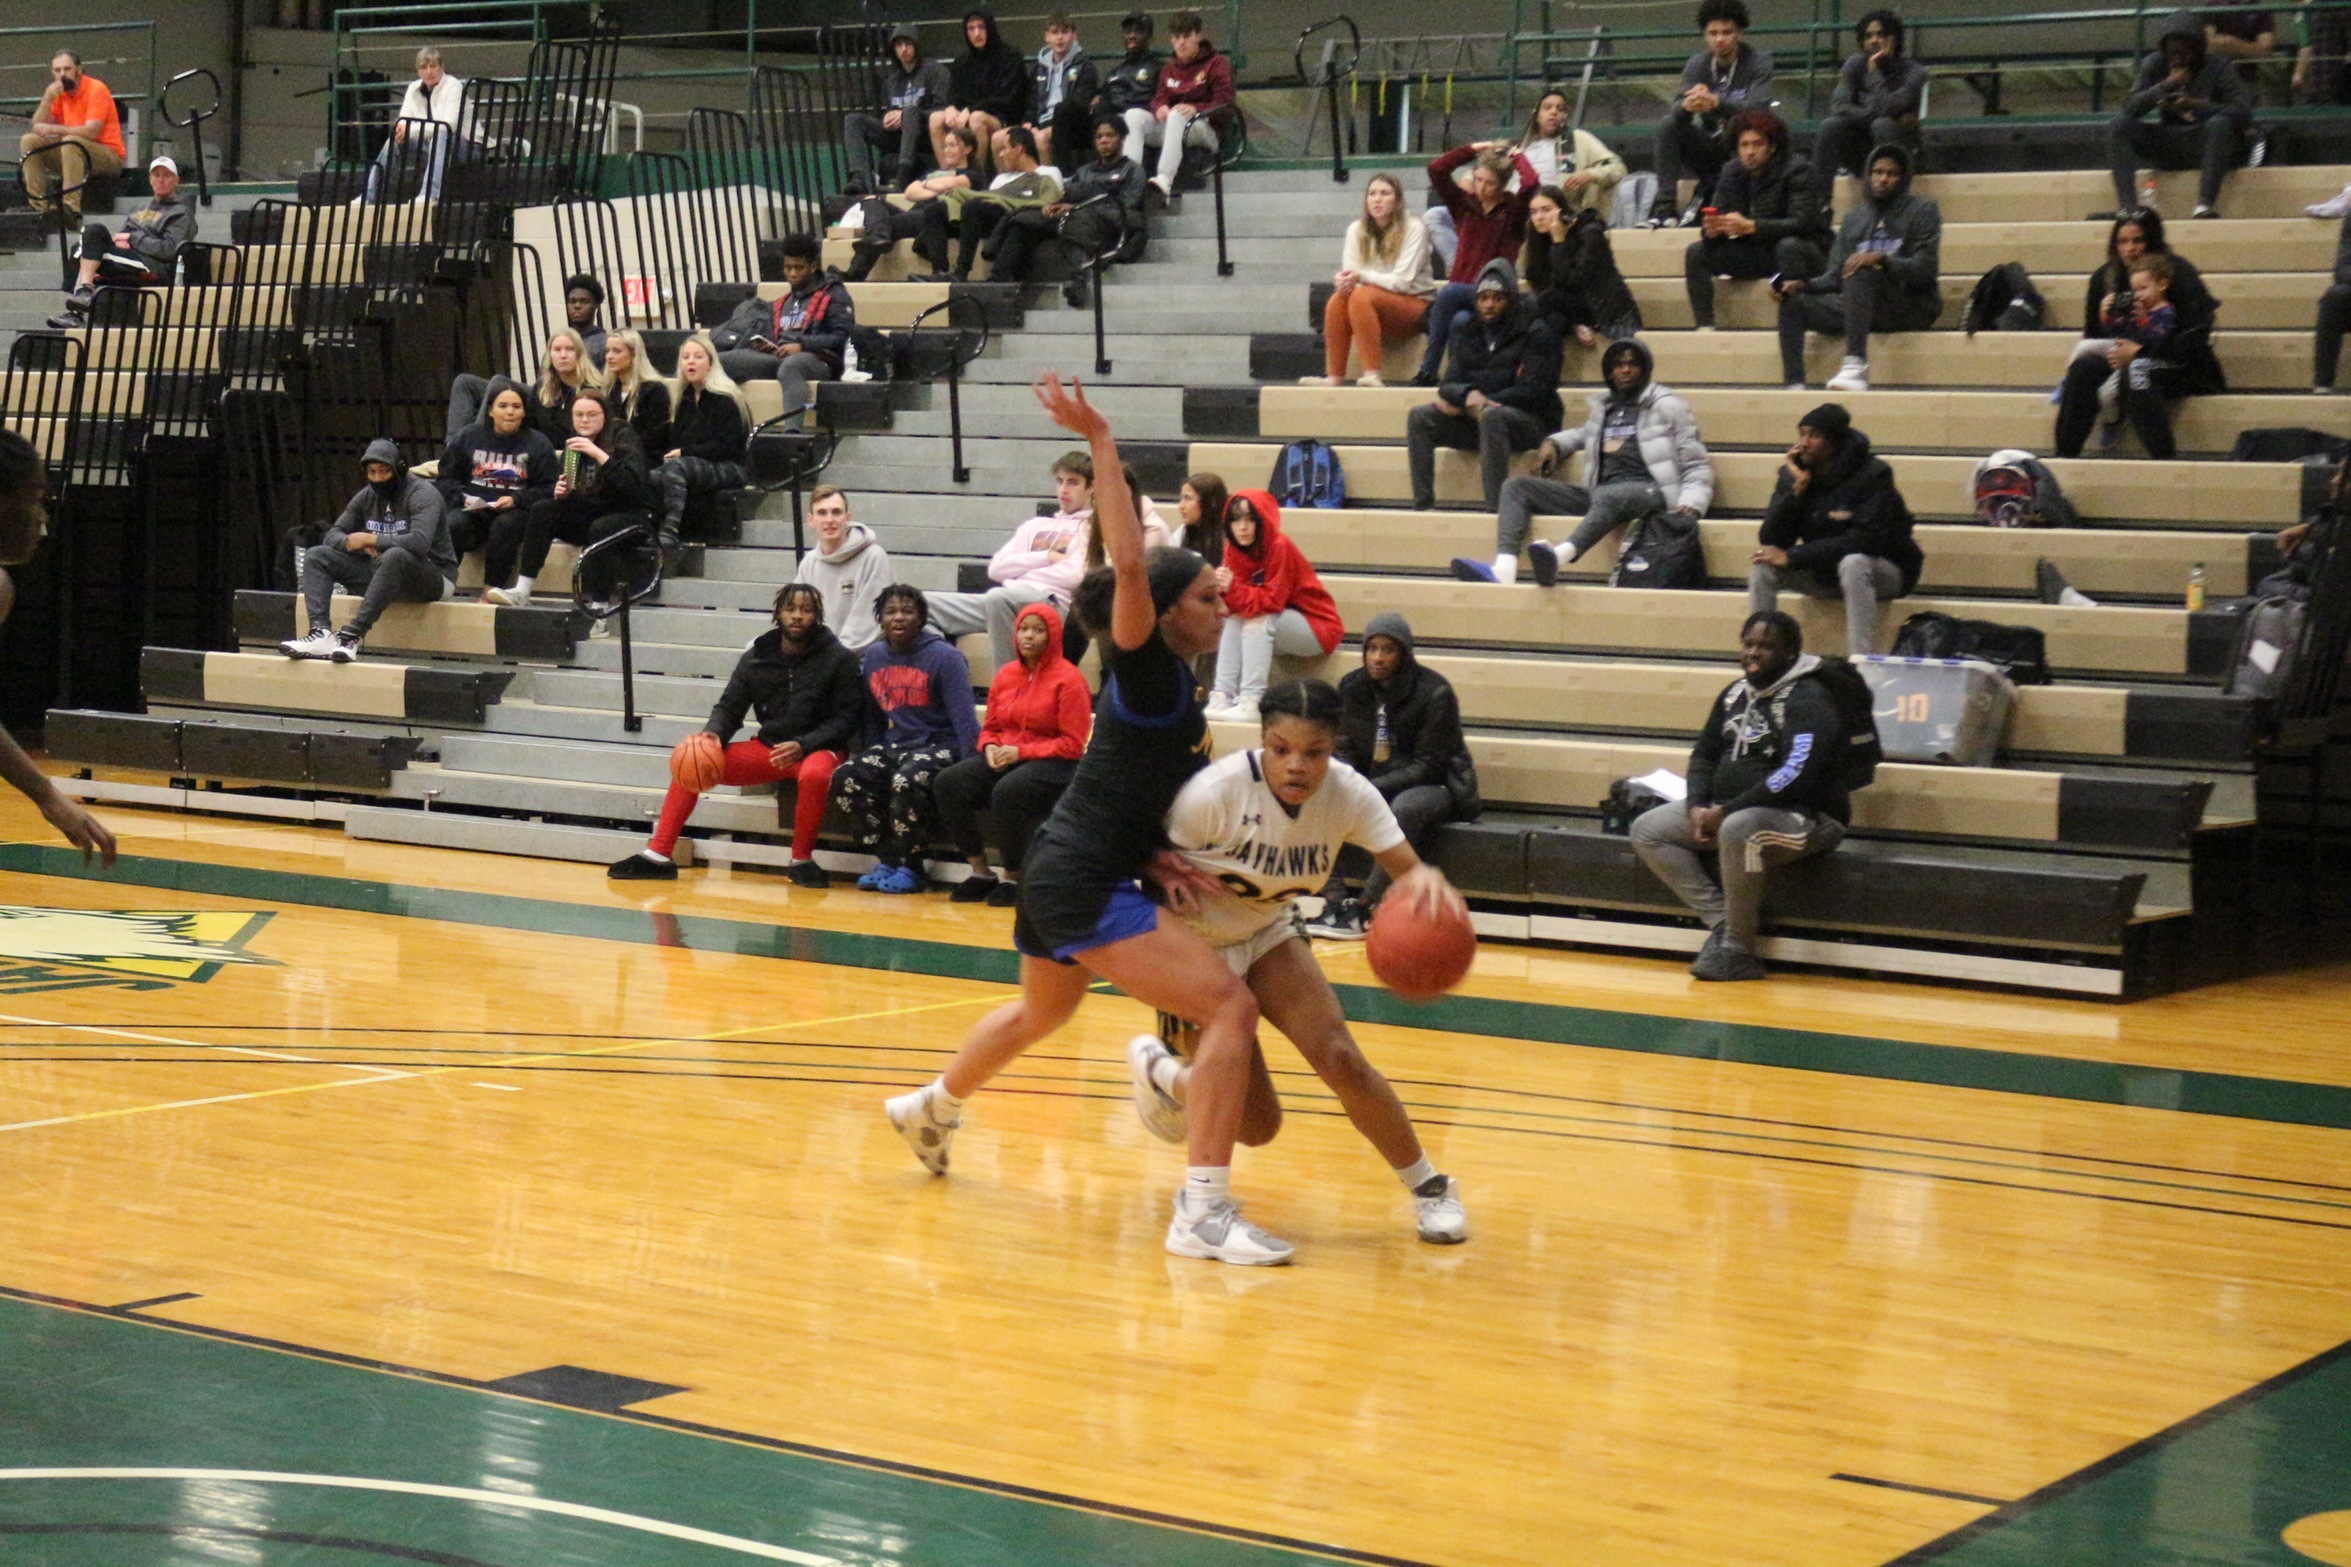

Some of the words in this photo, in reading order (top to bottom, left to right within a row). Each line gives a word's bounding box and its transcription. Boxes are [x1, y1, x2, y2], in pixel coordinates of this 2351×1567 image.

[624, 278, 654, 304] EXT
[1896, 694, 1929, 721] 10
[1225, 841, 1329, 877] JAYHAWKS
